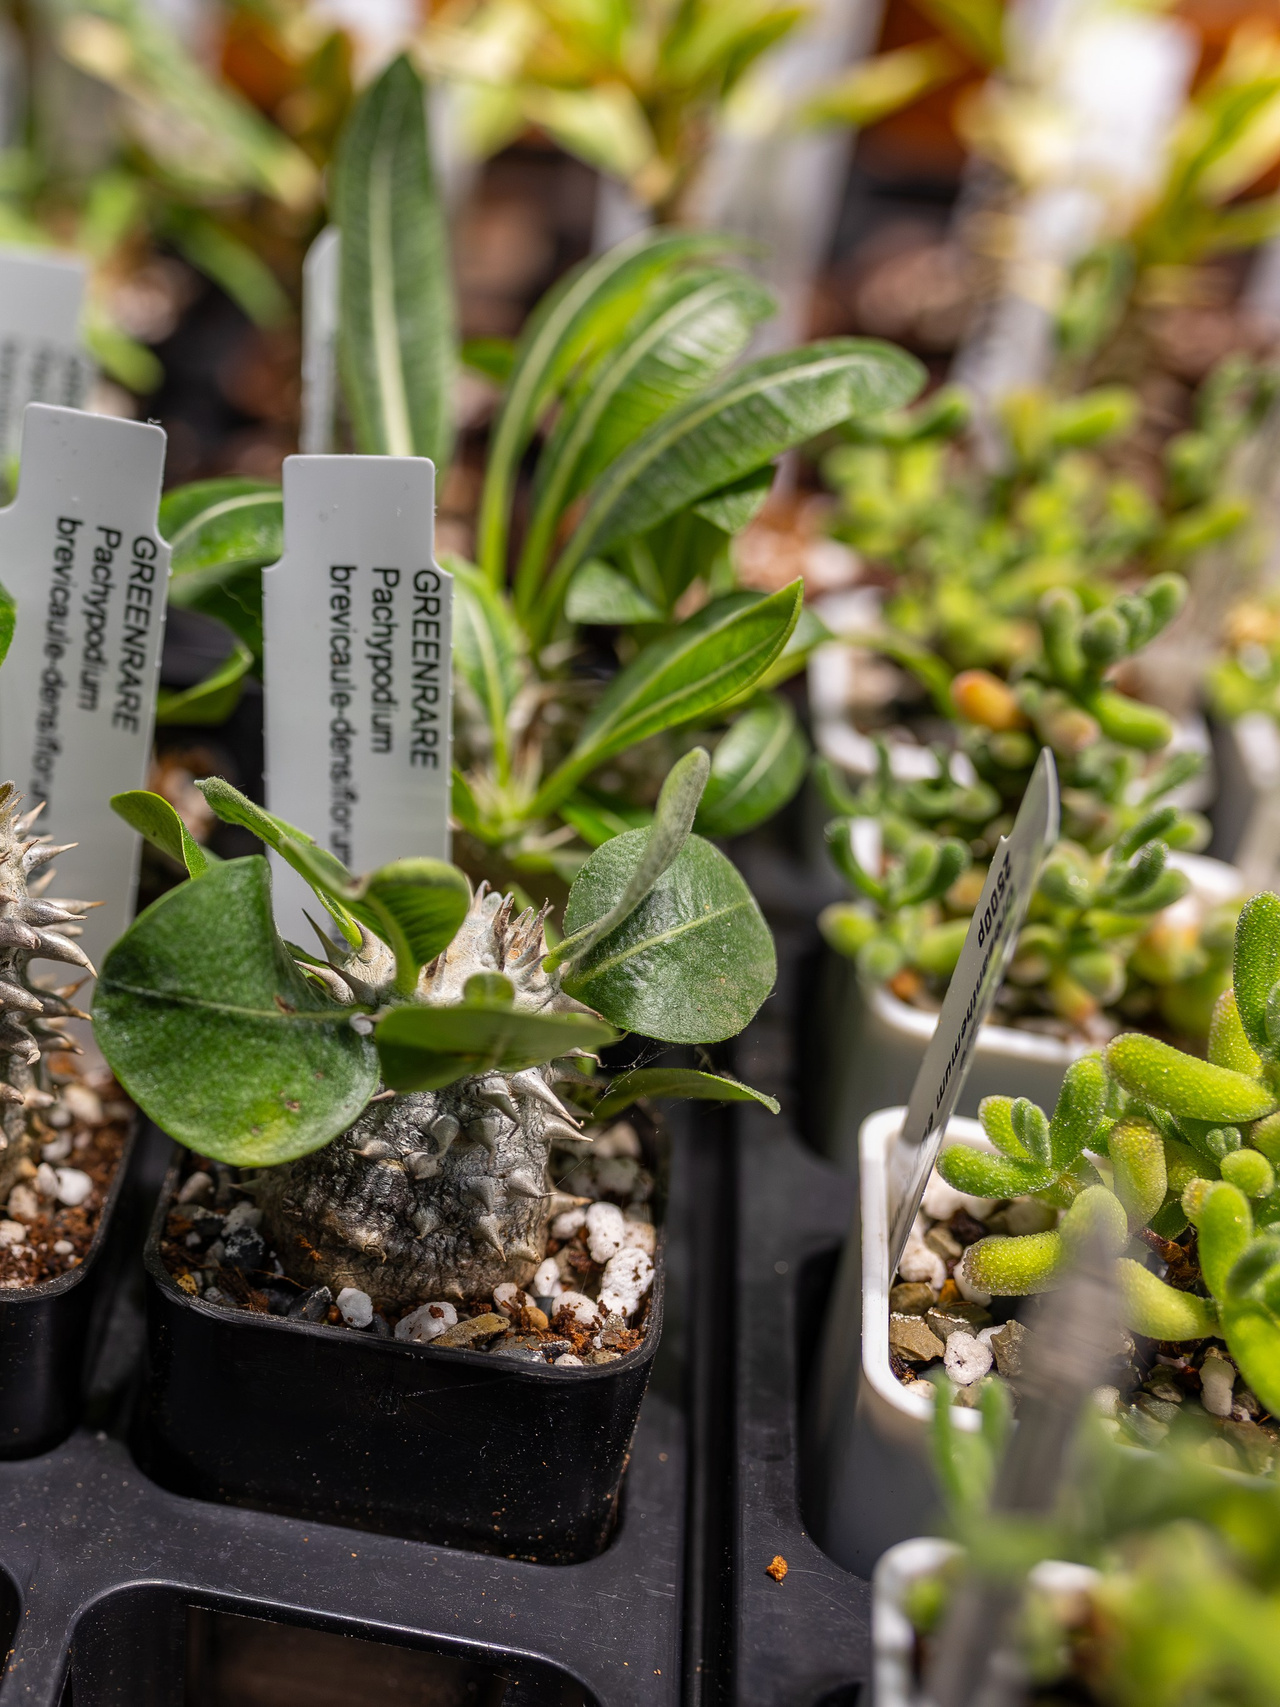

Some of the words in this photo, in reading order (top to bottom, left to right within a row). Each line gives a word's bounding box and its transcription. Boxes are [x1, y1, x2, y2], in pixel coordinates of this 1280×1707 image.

[77, 525, 122, 712] Pachypodium
[112, 535, 158, 734] GREENRARE
[365, 567, 400, 754] Pachypodium
[410, 569, 441, 770] GREENRARE
[978, 849, 1012, 948] 2500p
